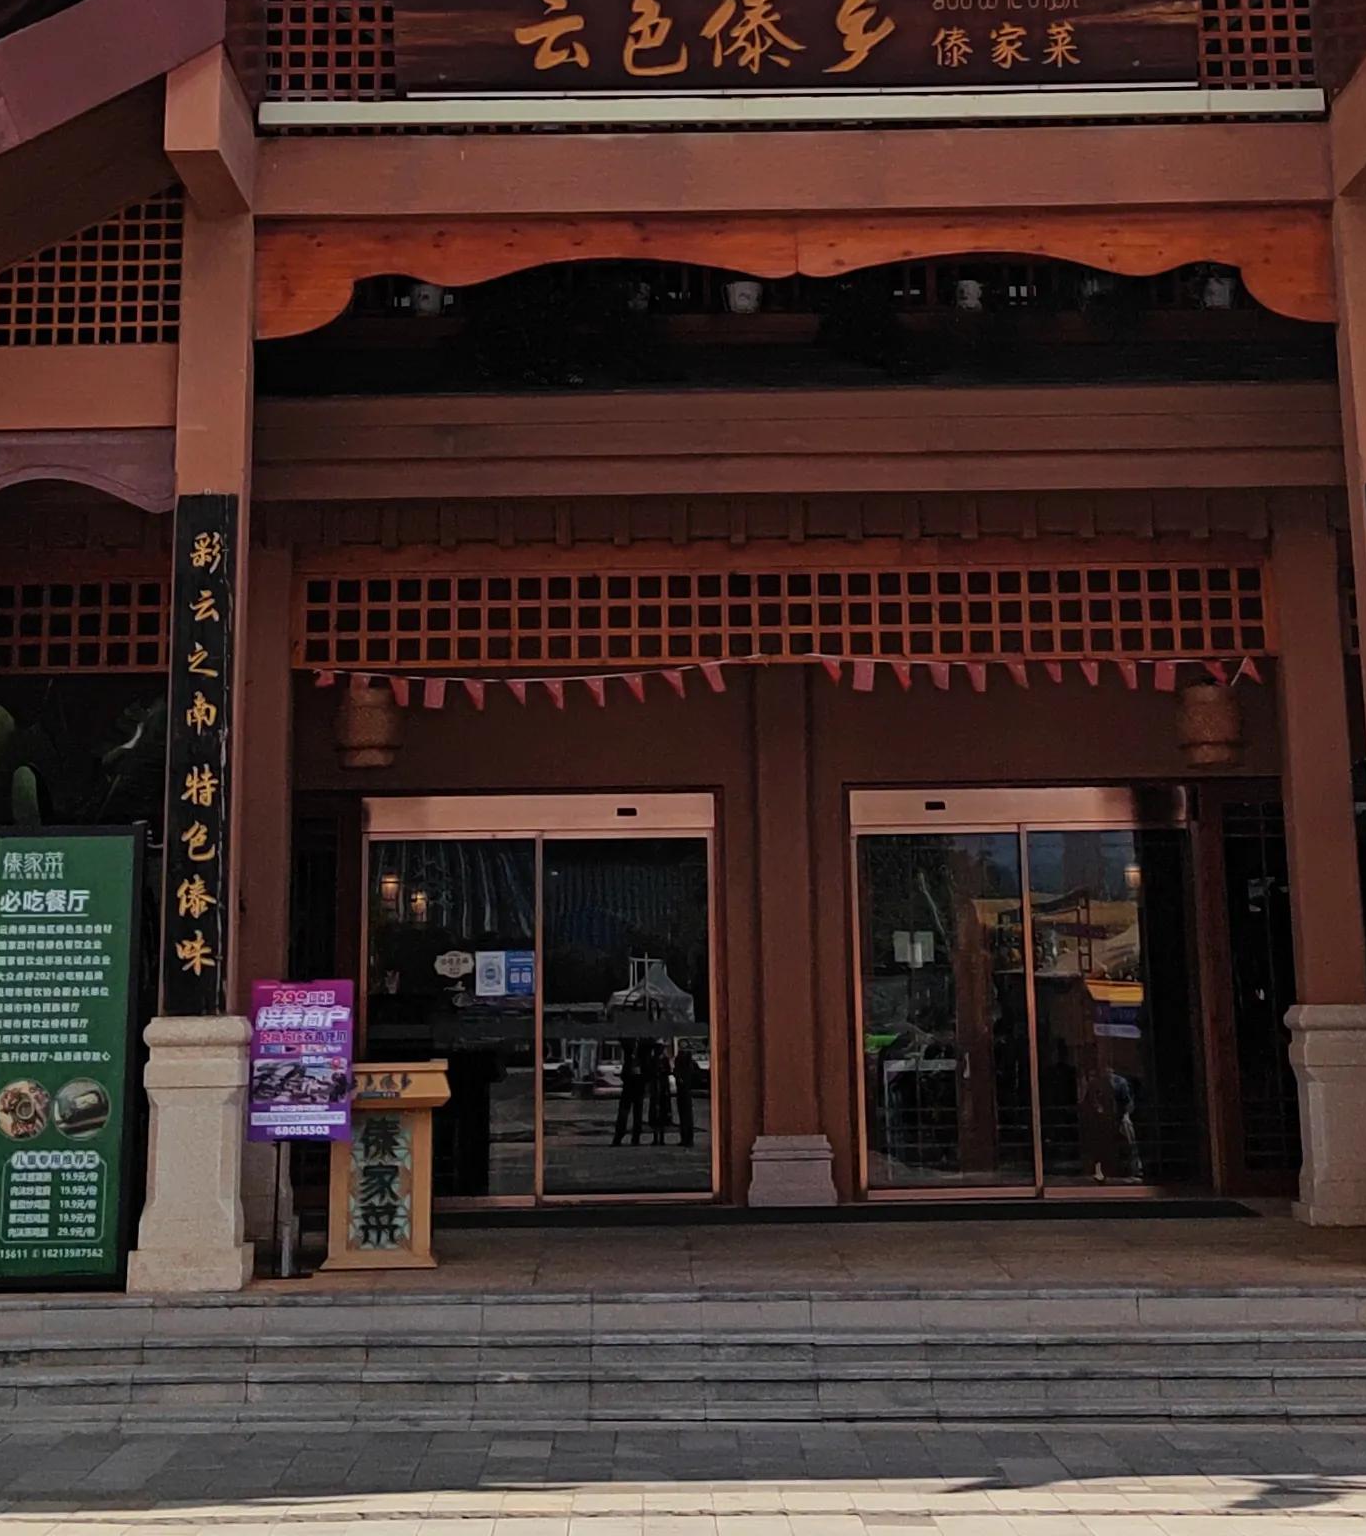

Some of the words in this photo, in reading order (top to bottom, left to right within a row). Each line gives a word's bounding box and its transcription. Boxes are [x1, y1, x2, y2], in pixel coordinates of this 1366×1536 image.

[931, 21, 1081, 70] 傣家菜
[175, 531, 227, 977] 彩云之南特色傣味
[2, 851, 65, 873] 傣家菜
[0, 889, 91, 913] 必吃餐厅
[358, 1117, 402, 1248] 傣家菜
